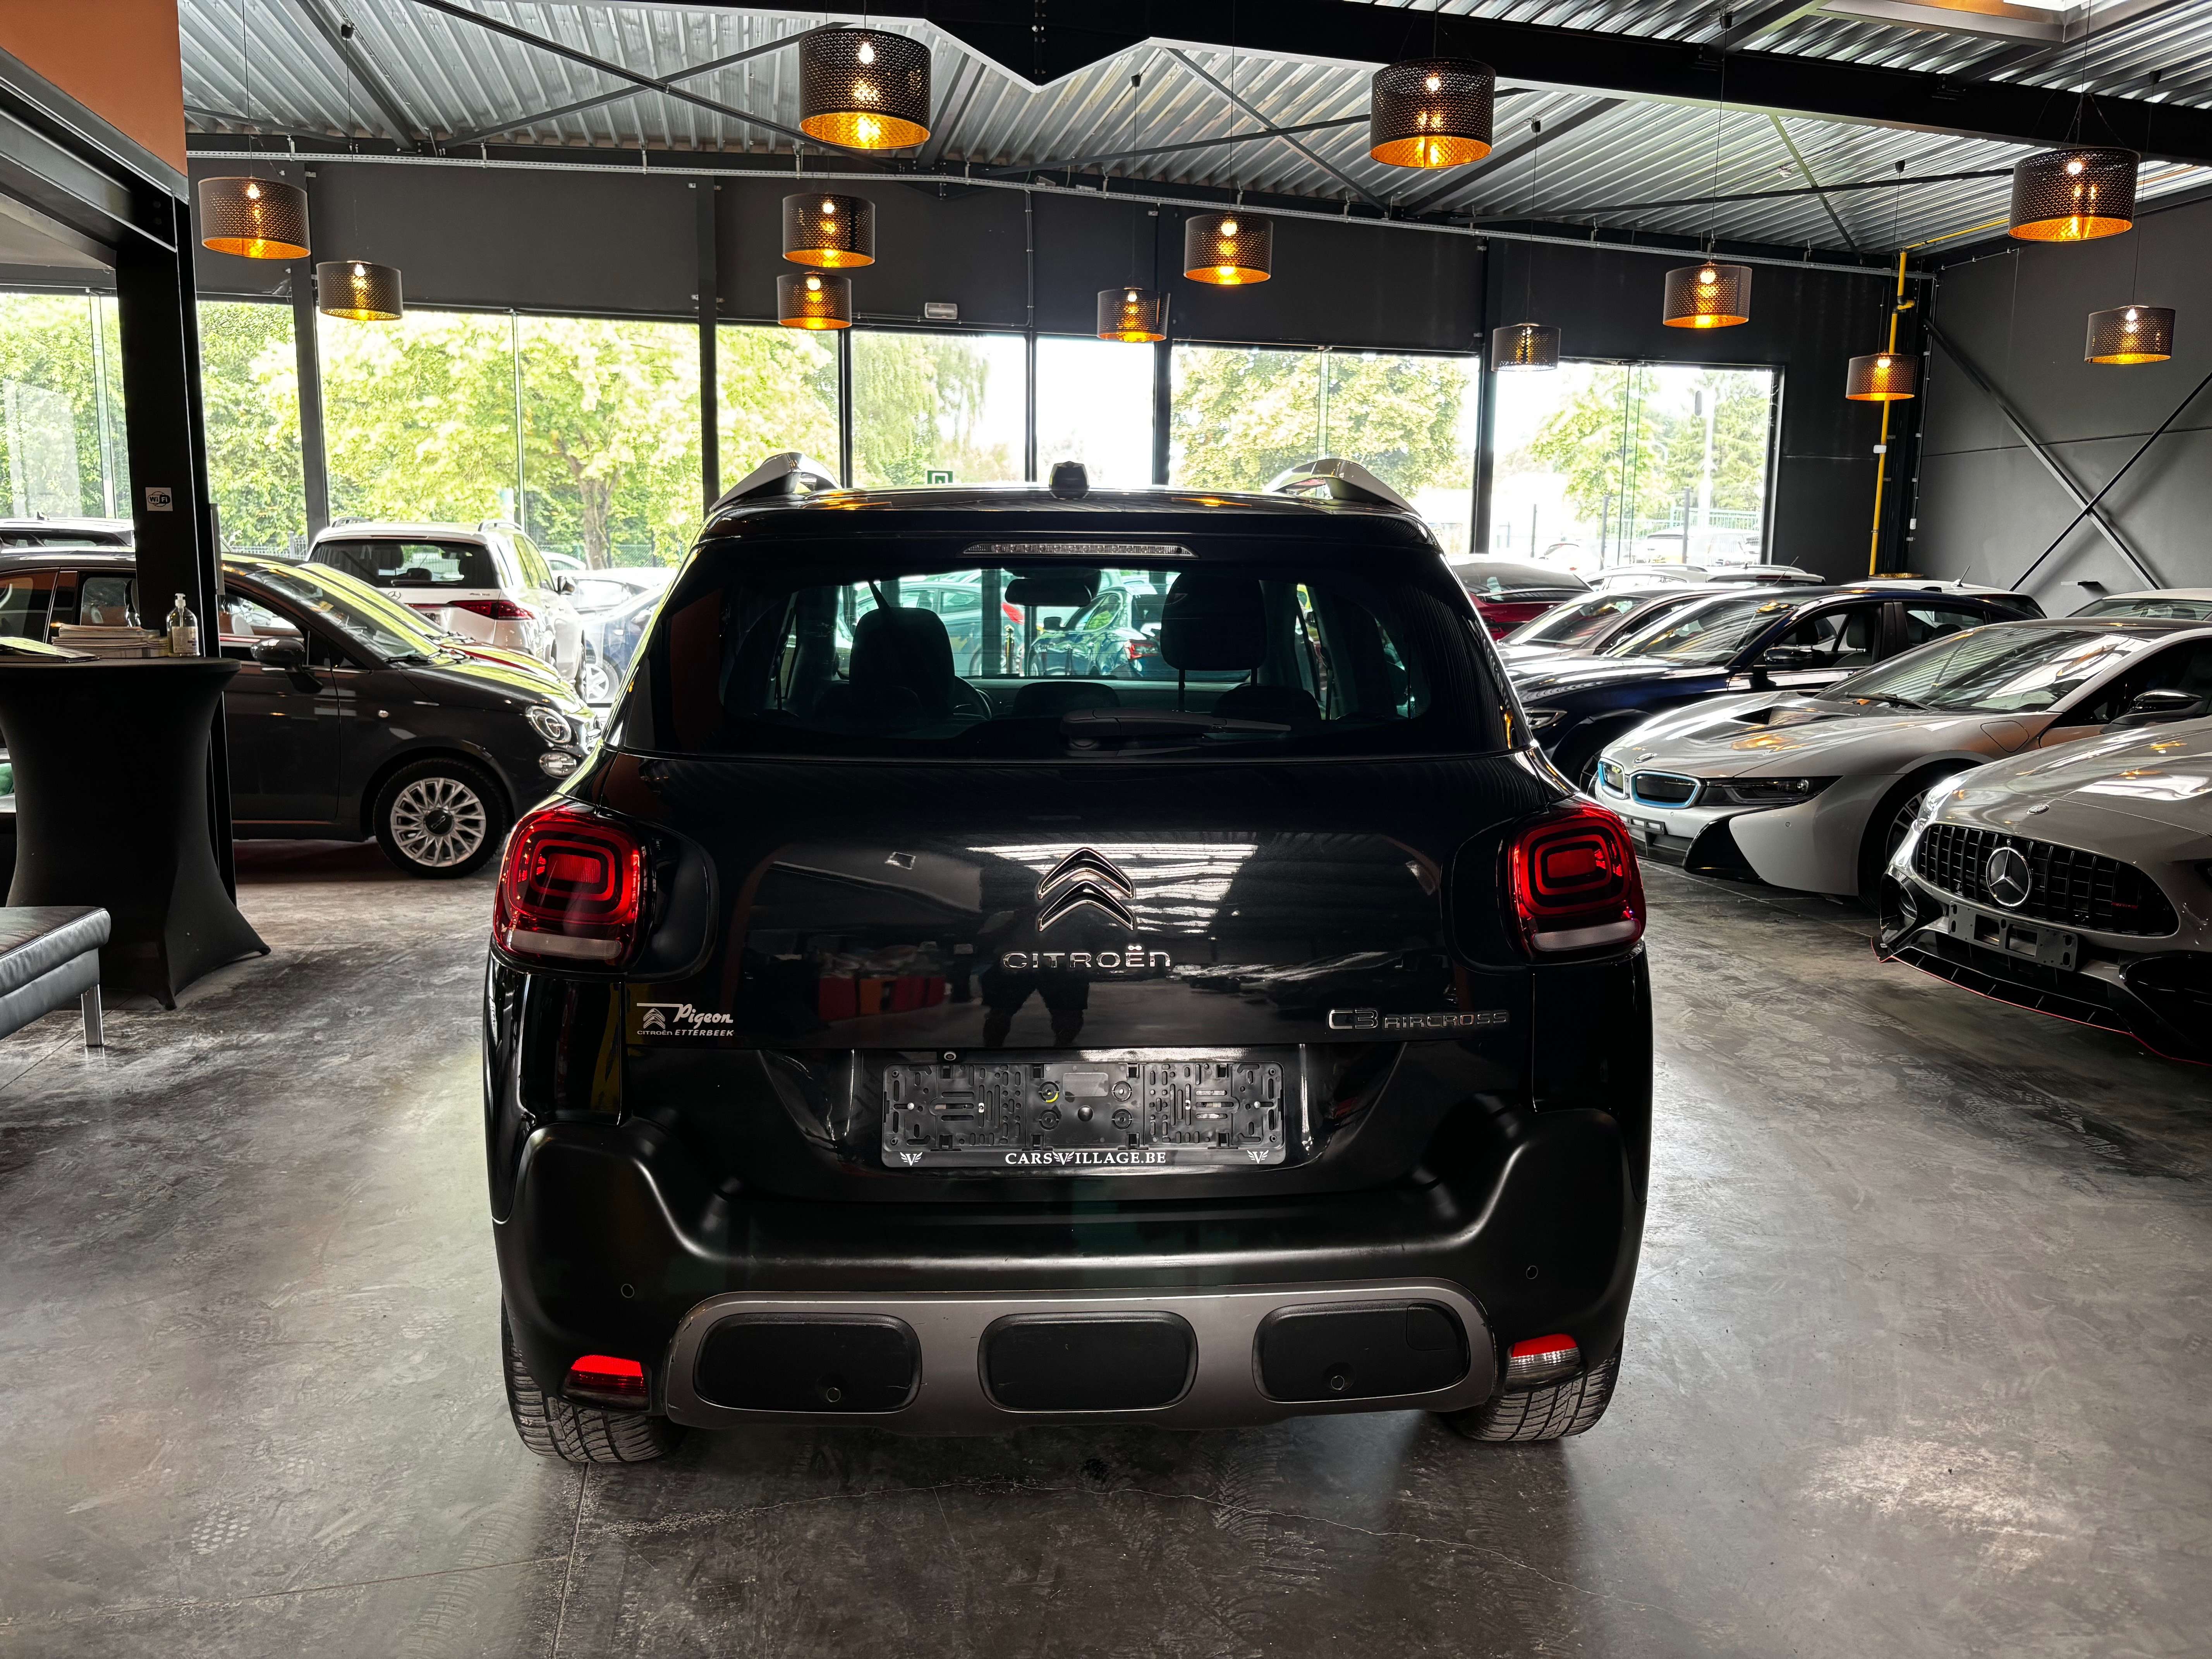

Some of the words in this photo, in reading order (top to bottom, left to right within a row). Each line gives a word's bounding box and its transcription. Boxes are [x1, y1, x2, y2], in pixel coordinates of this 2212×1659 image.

[673, 1003, 733, 1029] Pigeon
[1328, 1009, 1378, 1029] C3
[1384, 1012, 1507, 1029] AIRCROSS
[1005, 1151, 1166, 1165] CARSVILLAGE.BE
